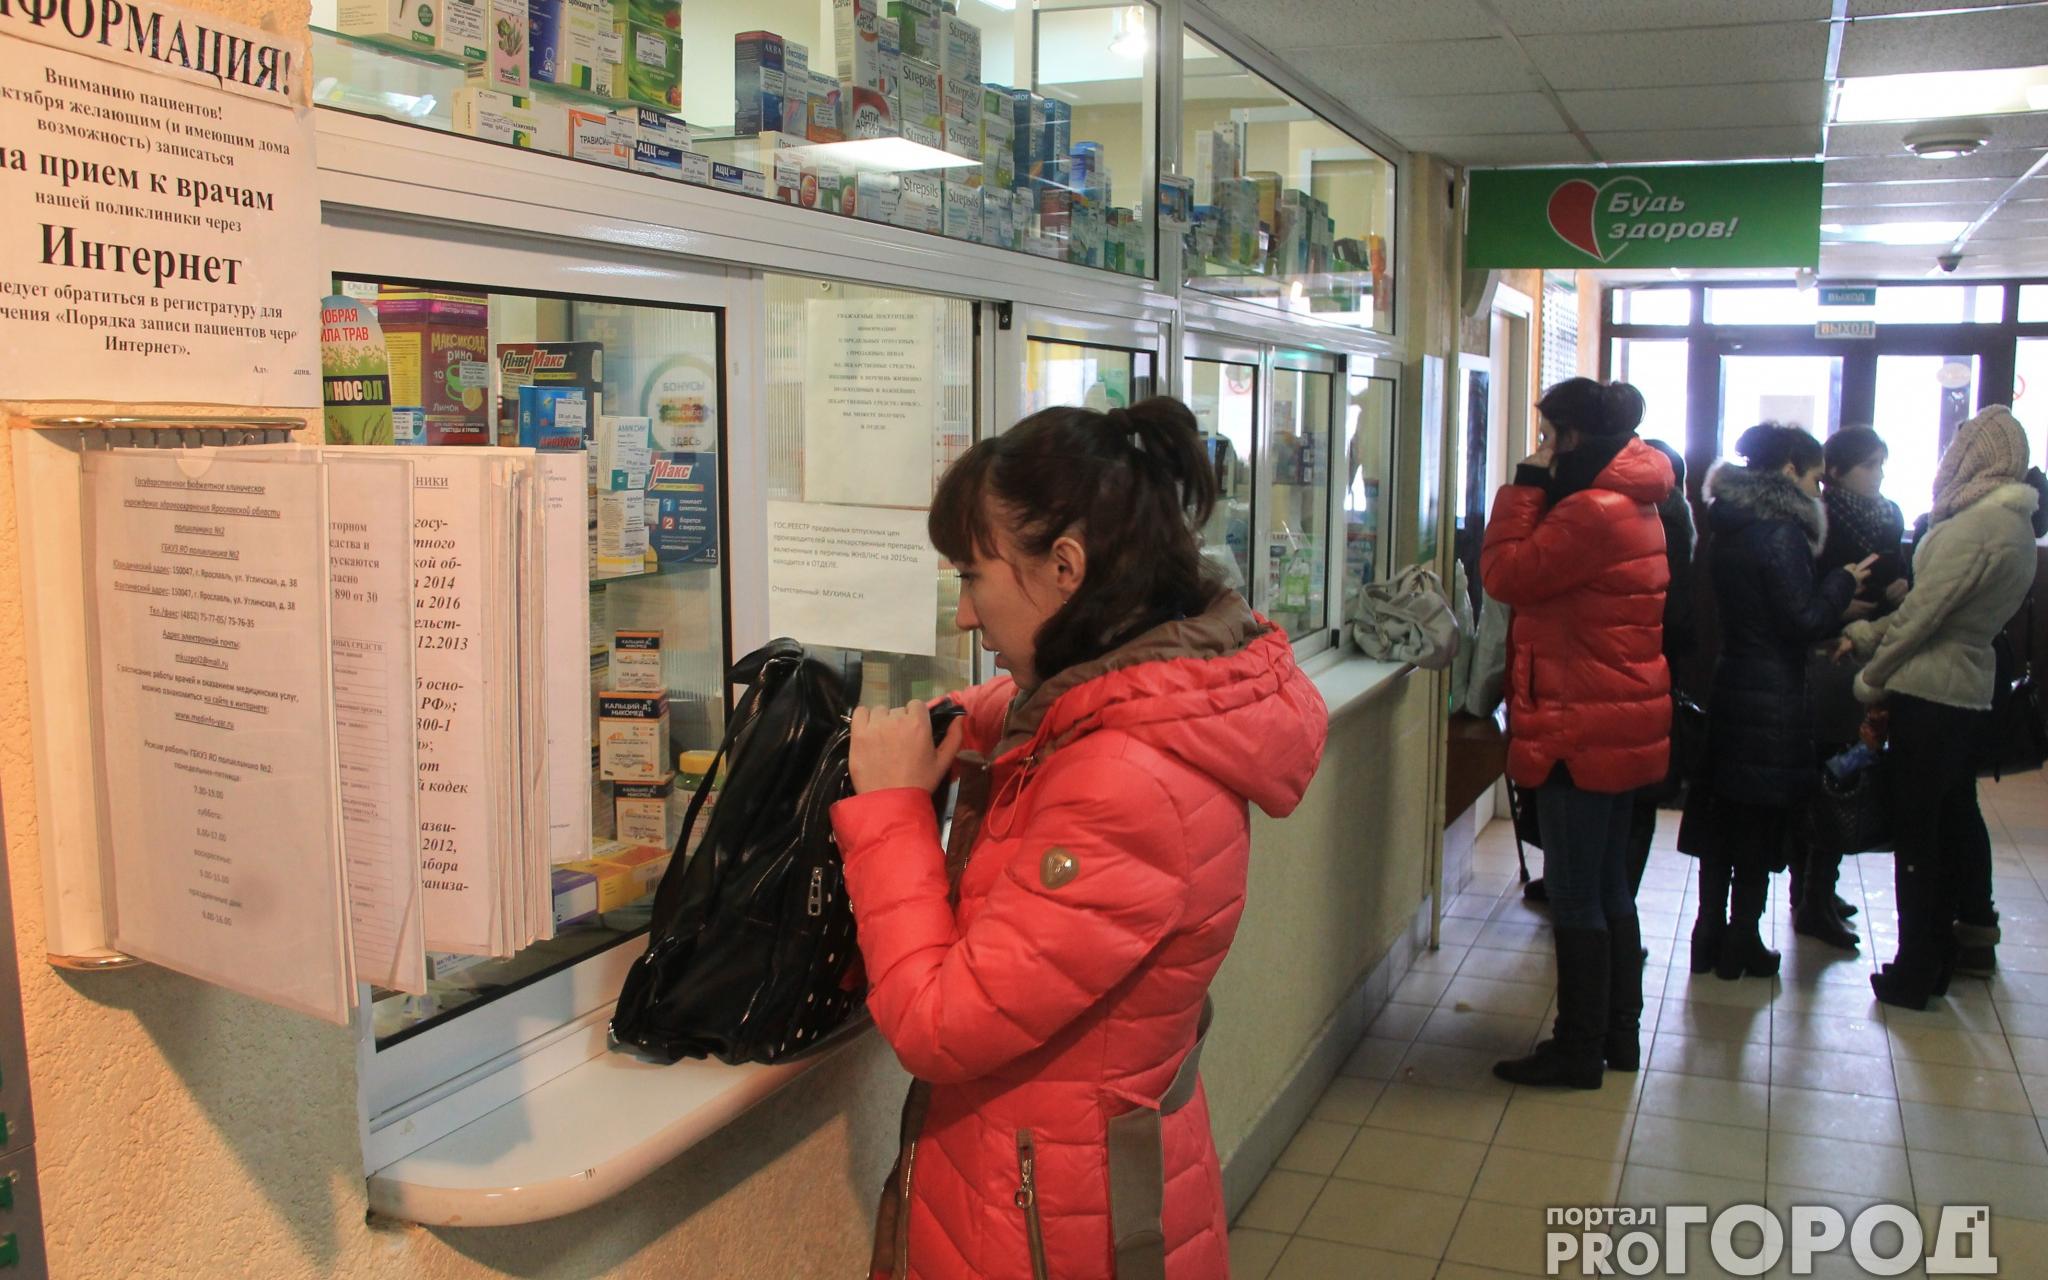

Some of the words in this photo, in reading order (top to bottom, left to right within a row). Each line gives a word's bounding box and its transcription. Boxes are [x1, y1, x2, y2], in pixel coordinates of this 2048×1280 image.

[903, 65, 936, 90] Strepsils
[45, 67, 135, 102] Вниманию
[140, 91, 223, 120] пациентов!
[640, 110, 658, 124] АЦЦ
[69, 101, 161, 129] желающим
[166, 118, 181, 134] (и
[185, 124, 255, 149] имеющим
[258, 140, 290, 156] дома
[37, 118, 151, 154] возможность)
[156, 141, 235, 167] записаться
[949, 127, 978, 150] Strepsils
[638, 144, 657, 158] АЦЦ
[715, 165, 729, 177] АЦЦ
[39, 153, 139, 191] прием
[150, 172, 168, 194] к
[176, 180, 274, 212] врачам
[904, 178, 938, 199] Strepsils
[949, 189, 979, 208] Strepsils
[1608, 192, 1685, 217] Будь
[35, 191, 90, 211] нашей
[95, 201, 201, 227] поликлиники
[205, 217, 242, 233] через
[1608, 217, 1738, 243] здоров!
[37, 222, 243, 289] Интернет
[54, 283, 145, 306] обратиться
[150, 298, 159, 307] в
[163, 297, 257, 319] регистратуру
[260, 307, 282, 319] для
[55, 308, 135, 330] «Порядка
[140, 318, 190, 333] записи
[194, 323, 266, 340] пациентов
[1821, 321, 1869, 336] ВЫХОД
[343, 326, 369, 342] ТРАВ
[105, 335, 191, 357] Интернет».
[440, 556, 462, 570] об-
[423, 575, 456, 590] 2014
[334, 590, 351, 601] 890
[428, 595, 461, 610] 2016
[417, 635, 468, 652] 12.2013
[426, 679, 464, 692] осно-
[421, 696, 457, 714] РФ»;
[419, 761, 440, 772] от
[428, 781, 469, 794] кодек
[421, 821, 456, 833] азви-
[422, 837, 457, 854] 2012,
